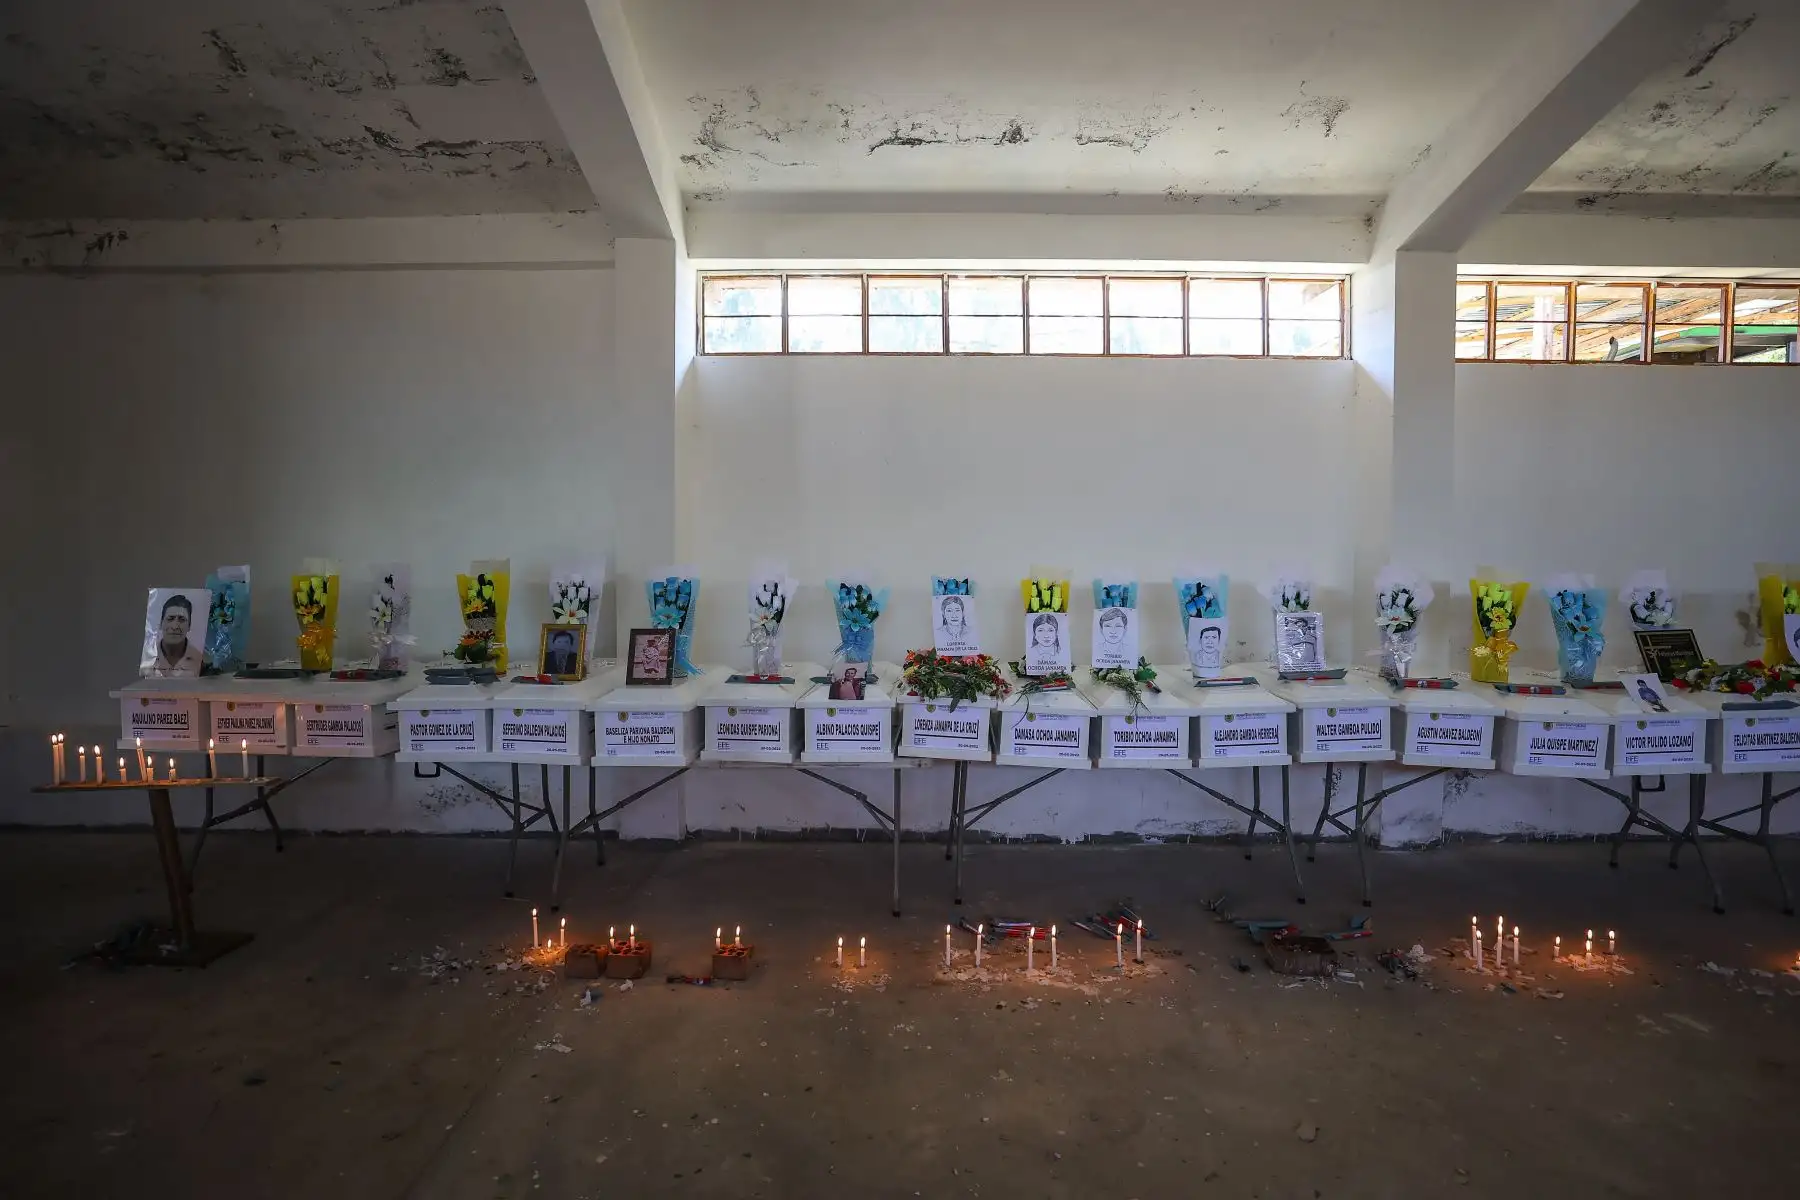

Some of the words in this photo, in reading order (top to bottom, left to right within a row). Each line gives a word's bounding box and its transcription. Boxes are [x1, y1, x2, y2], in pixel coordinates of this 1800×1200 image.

[410, 724, 428, 736] PASTOR
[446, 724, 452, 736] DE
[453, 724, 459, 736] LA
[460, 724, 473, 736] CRUZ
[1316, 724, 1337, 736] WALTER
[1360, 722, 1379, 734] PULIDO
[1530, 738, 1546, 750] JULIA
[1546, 738, 1567, 751] QUISPE
[1567, 740, 1596, 752] MARTINEZ
[1626, 736, 1646, 749] VICTOR
[1647, 736, 1668, 748] PULIDO
[1669, 736, 1692, 748] LOZANO
